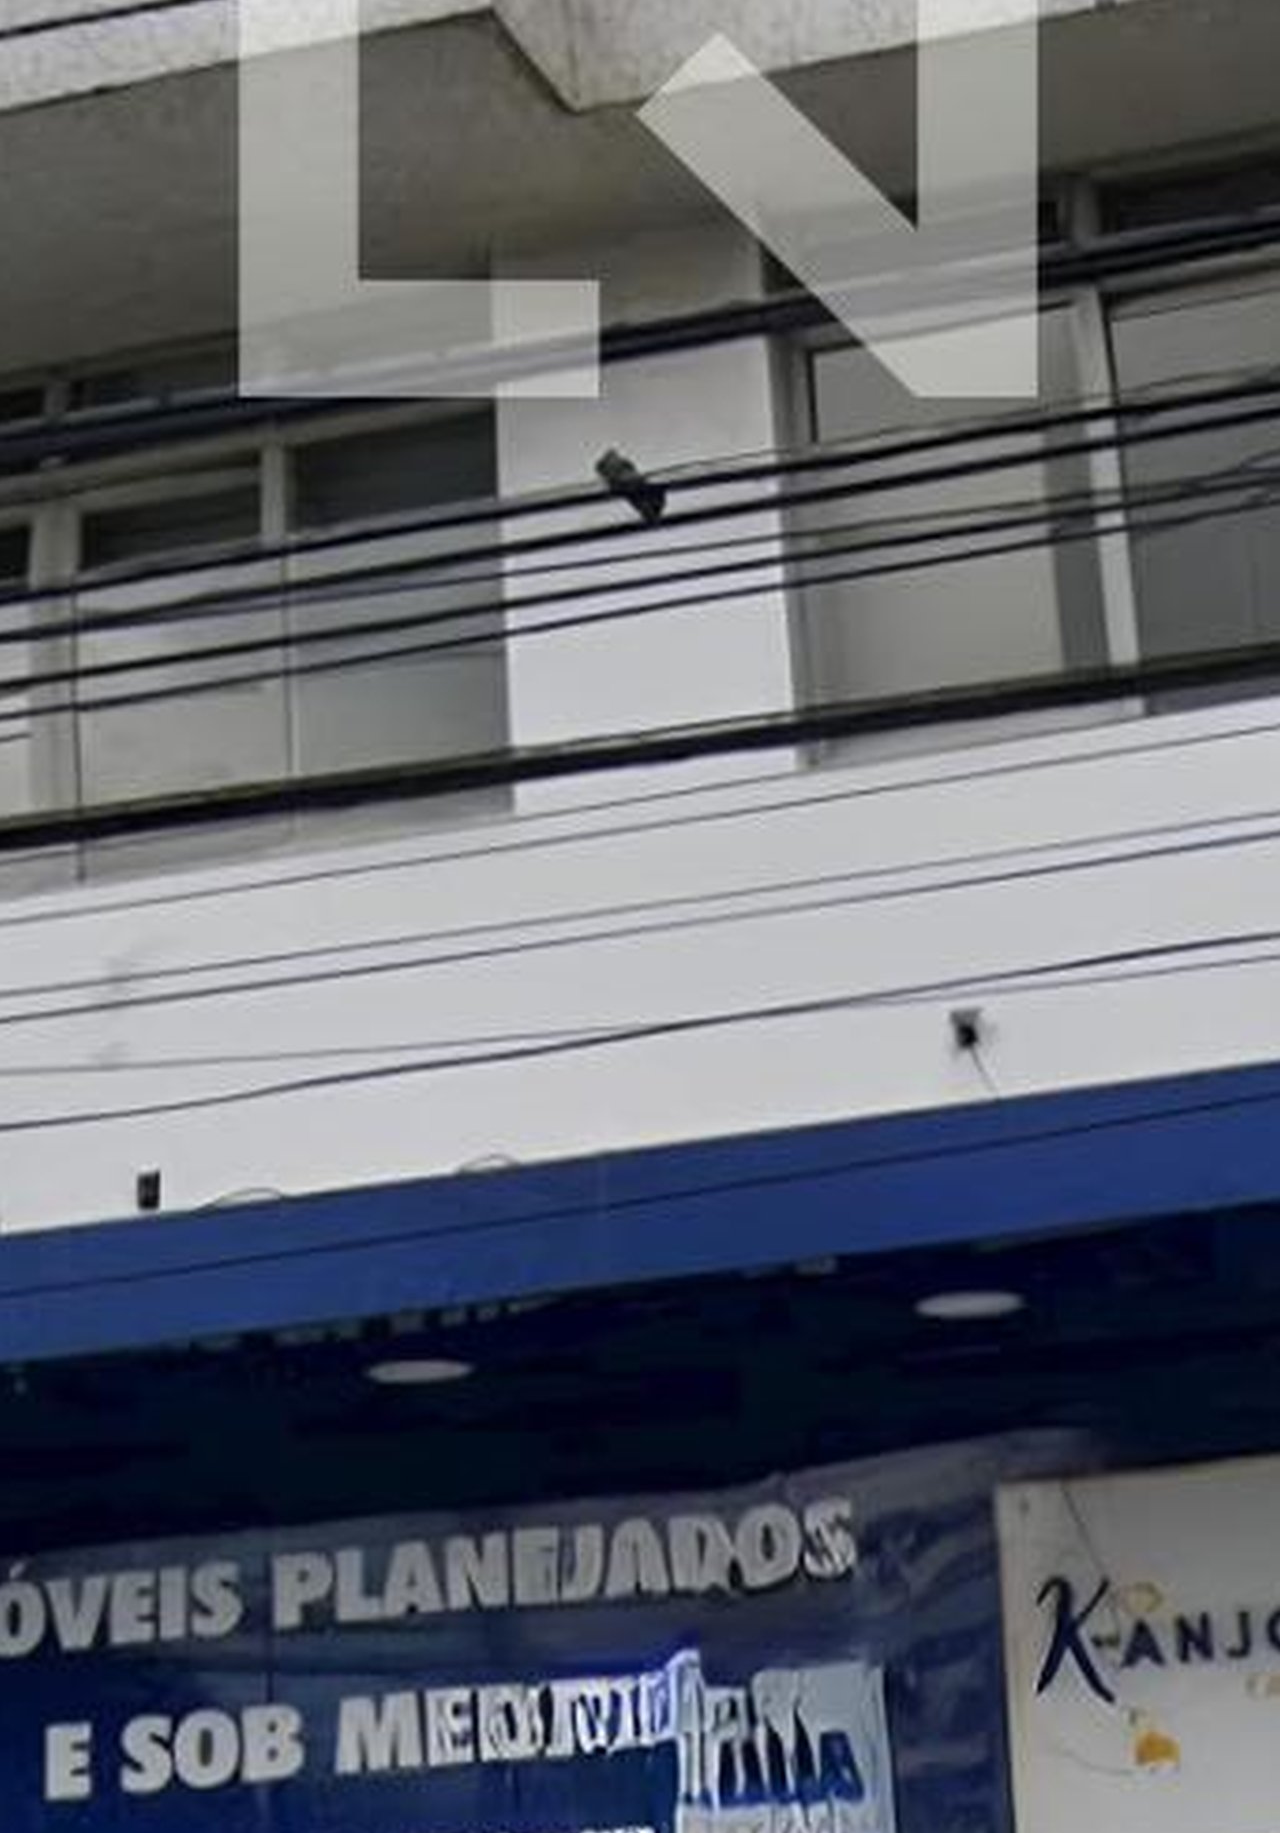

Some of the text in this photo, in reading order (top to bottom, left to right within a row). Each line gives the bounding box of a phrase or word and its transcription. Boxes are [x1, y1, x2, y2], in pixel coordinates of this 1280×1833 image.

[272, 1498, 857, 1630] PLANEJADOS
[44, 1722, 92, 1802] E
[120, 1703, 305, 1796] SOB
